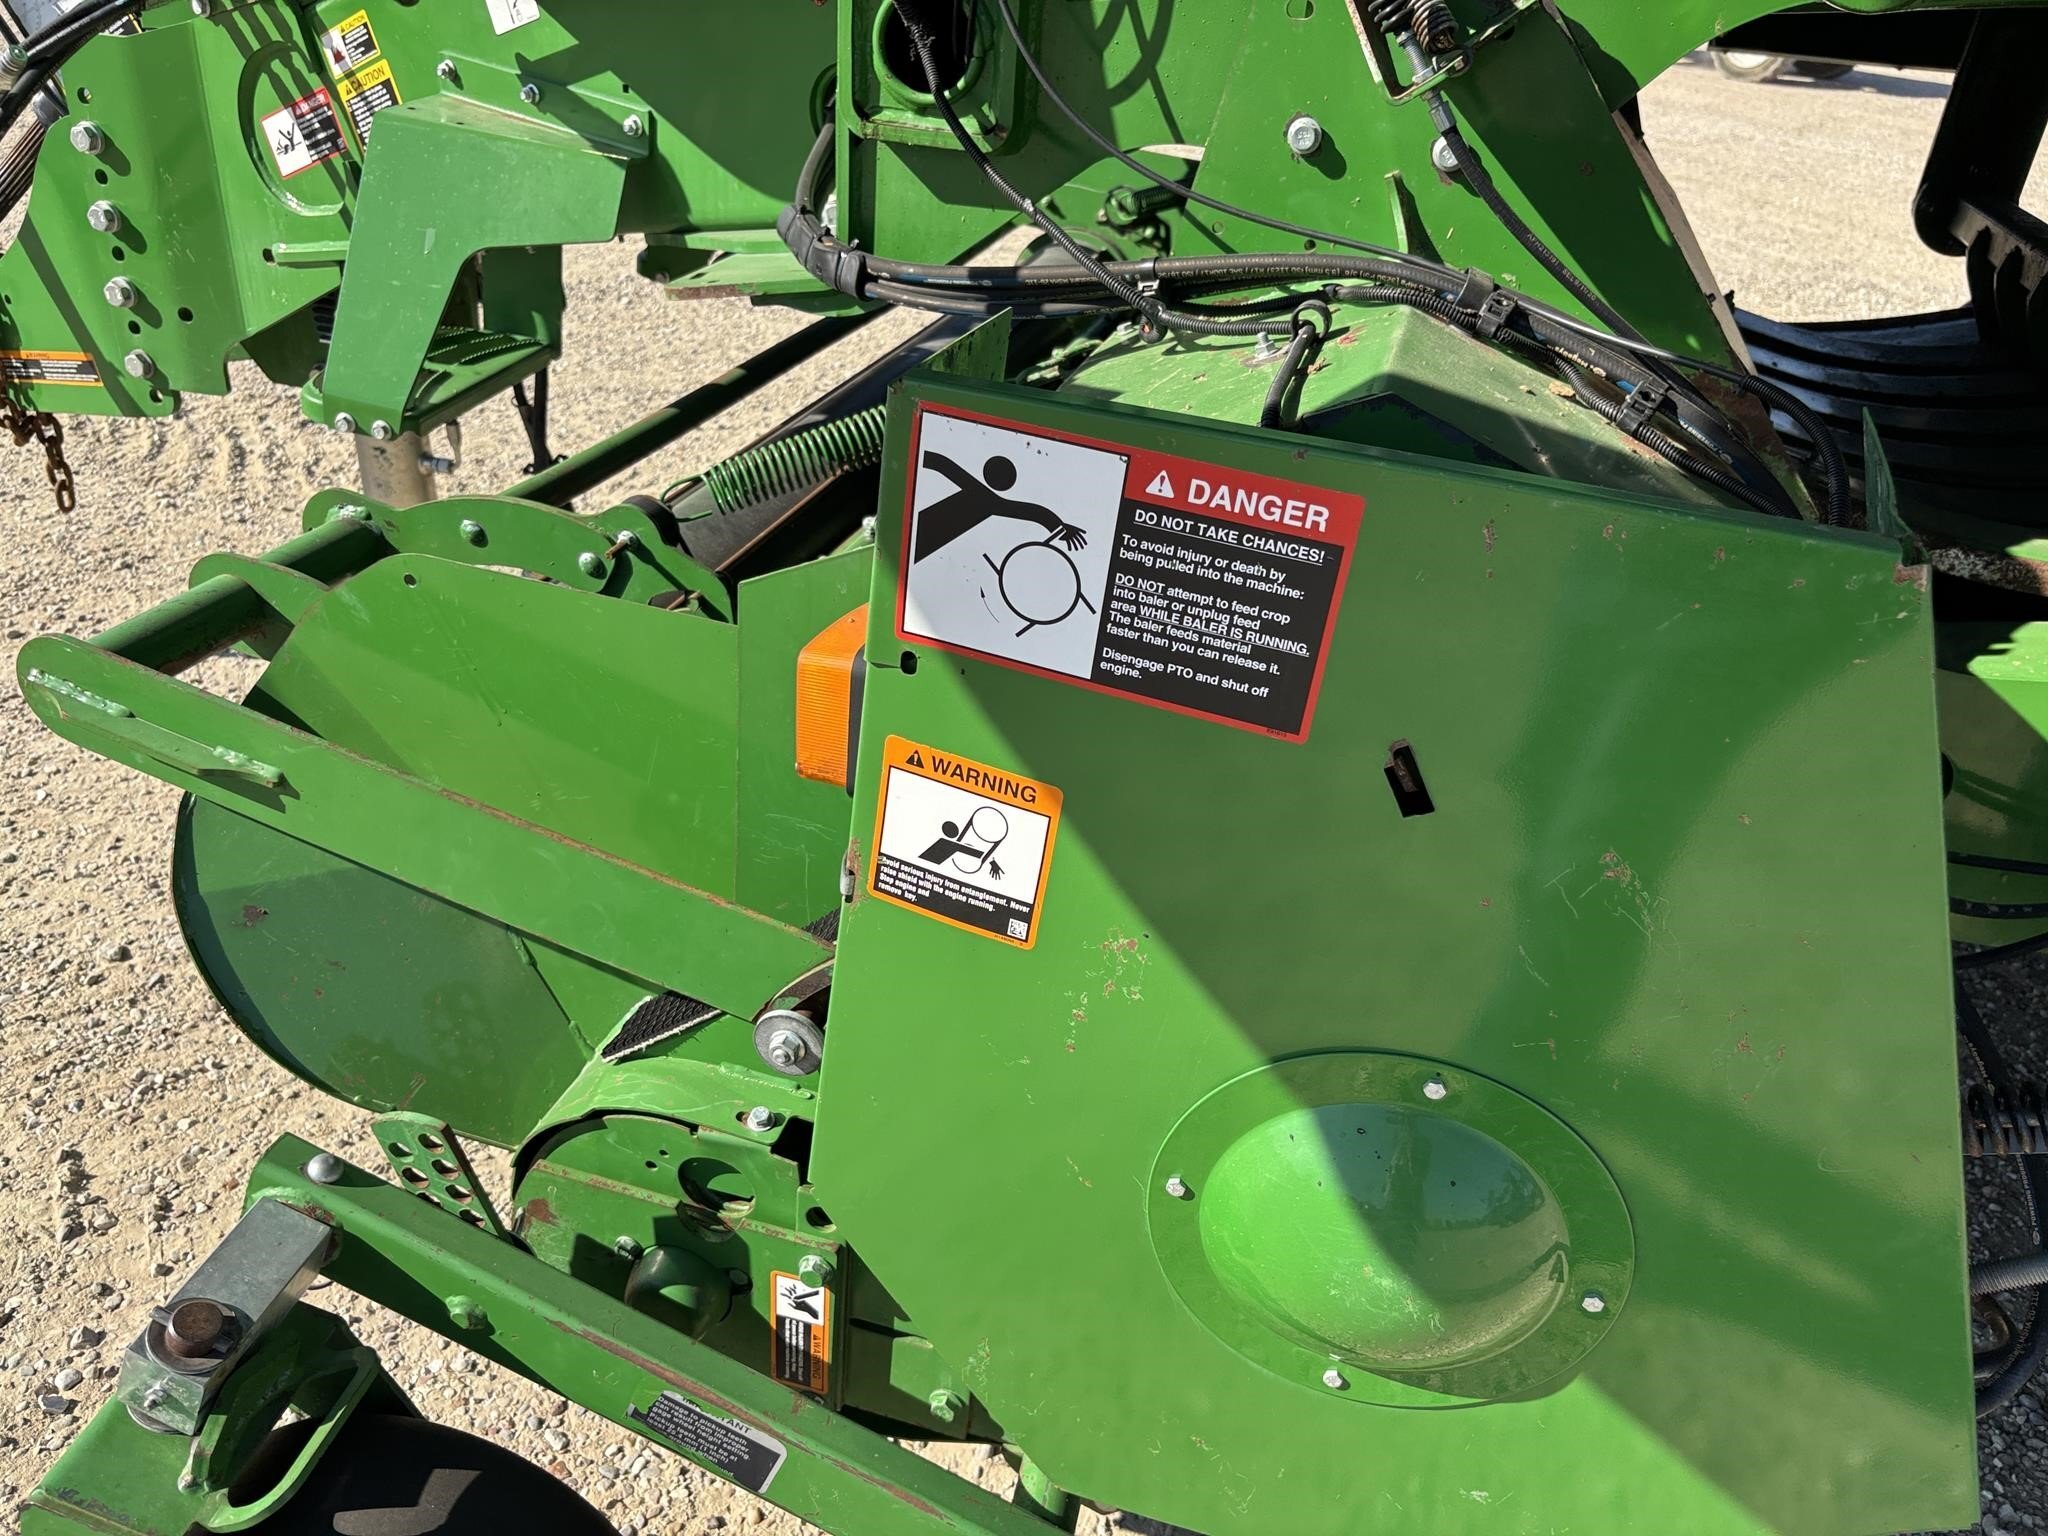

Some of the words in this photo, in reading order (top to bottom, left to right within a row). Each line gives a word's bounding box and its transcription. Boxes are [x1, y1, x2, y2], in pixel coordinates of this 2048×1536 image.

[351, 66, 386, 93] CAUTION
[1188, 479, 1329, 532] DANGER
[1122, 534, 1138, 547] To
[1140, 541, 1174, 556] avoid
[1177, 547, 1212, 567] injury
[1215, 558, 1229, 568] or
[1231, 560, 1266, 577] death
[1269, 568, 1286, 583] by
[1135, 509, 1157, 524] DO
[1161, 515, 1194, 533] NOT
[1198, 523, 1239, 543] TAKE
[1242, 534, 1325, 563] CHANCES!
[1119, 547, 1153, 567] being
[1196, 565, 1220, 580] into
[1224, 572, 1243, 585] the
[1246, 579, 1304, 600] machine:
[1113, 585, 1136, 600] into
[1138, 592, 1169, 608] baler
[1171, 602, 1185, 611] or
[1187, 605, 1230, 625] unplug
[1233, 614, 1261, 630] feed
[1115, 573, 1134, 586] DO
[1137, 578, 1165, 594] NOT
[1167, 587, 1214, 606] attempt
[1216, 597, 1229, 609] to
[1231, 601, 1259, 616] feed
[1261, 610, 1290, 625] crop
[1107, 623, 1140, 640] faster
[1143, 632, 1169, 647] than
[1171, 641, 1195, 654] you
[1197, 648, 1219, 660] can
[1222, 654, 1267, 671] release
[1269, 663, 1280, 675] it.
[1109, 610, 1131, 625] The
[1133, 617, 1164, 633] baler
[1166, 625, 1199, 642] feeds
[1202, 636, 1252, 654] material
[1110, 600, 1136, 614] area
[1140, 605, 1180, 625] WHILE
[1183, 615, 1228, 637] BALER
[1230, 627, 1243, 639] IS
[1246, 631, 1309, 657] RUNNING.
[1100, 661, 1142, 679] engine.
[1102, 647, 1164, 672] Disengage
[1167, 663, 1193, 678] PTO
[1195, 673, 1219, 685] and
[1221, 679, 1249, 693] shut
[1251, 687, 1269, 697] off
[932, 756, 1036, 804] WARNING
